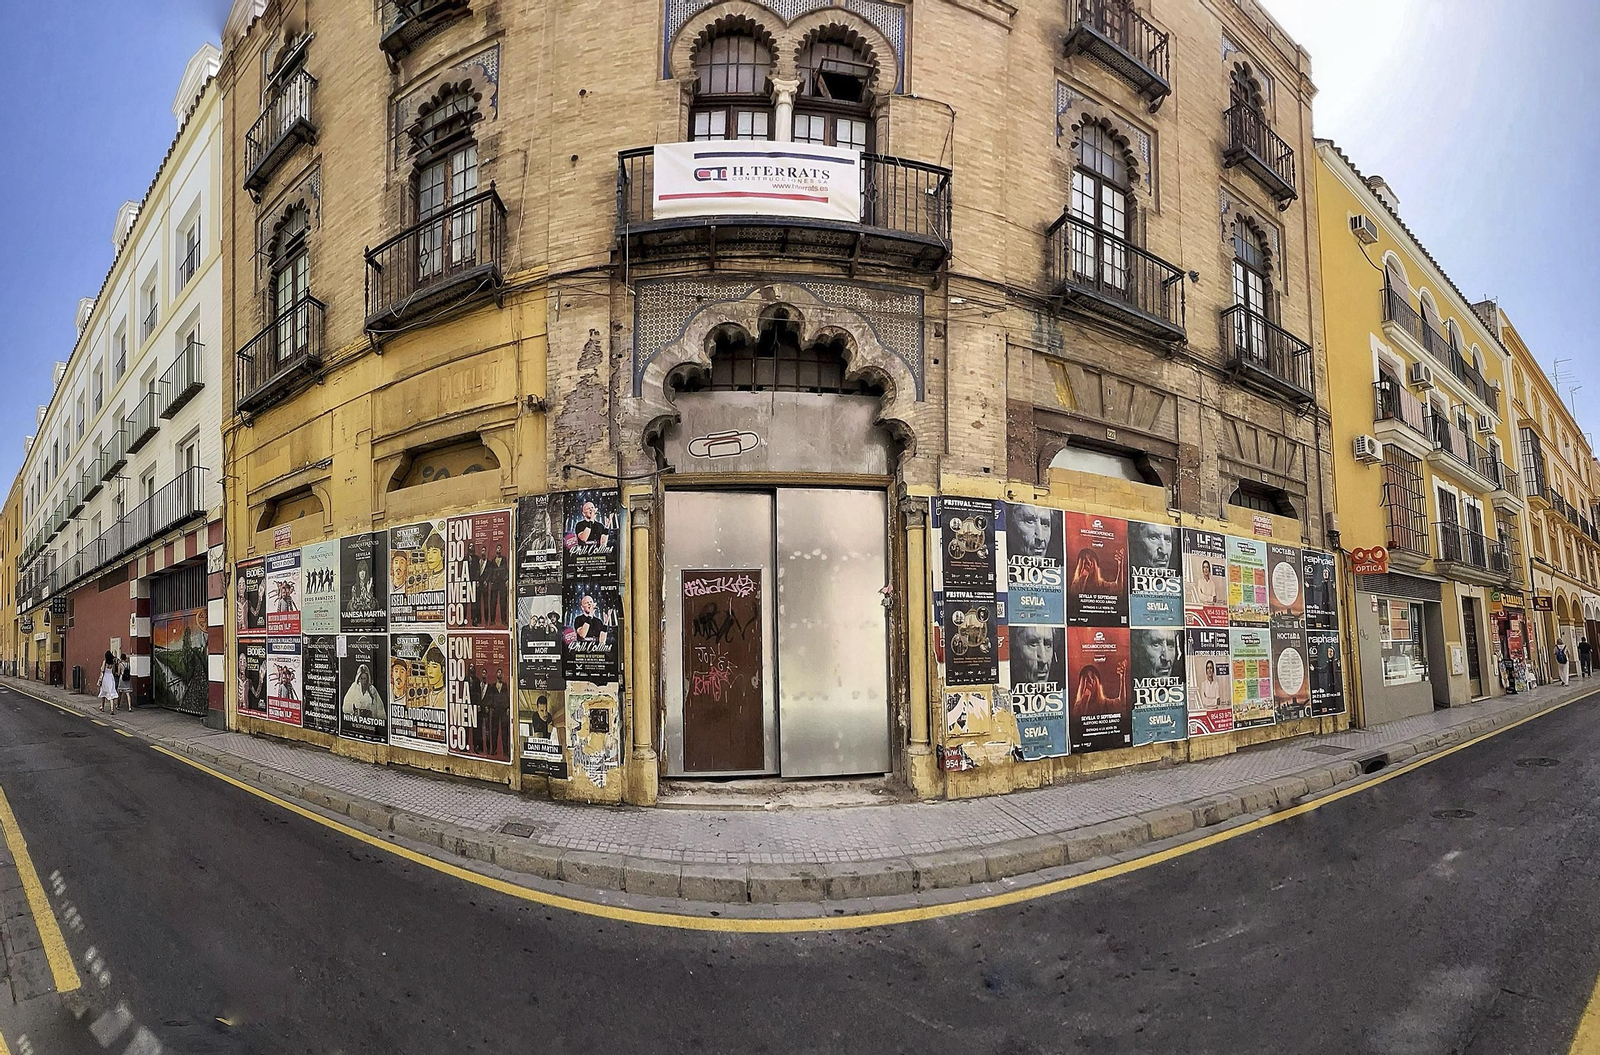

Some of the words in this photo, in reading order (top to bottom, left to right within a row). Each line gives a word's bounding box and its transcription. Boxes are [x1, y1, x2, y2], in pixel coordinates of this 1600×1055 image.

[733, 166, 830, 180] H.TERRATS
[772, 183, 828, 192] www.hterrats.es
[448, 519, 472, 541] FON
[1197, 533, 1210, 545] ILF
[448, 541, 464, 561] DO
[588, 545, 614, 556] Collins
[1007, 555, 1060, 568] MIGUEL
[1304, 556, 1335, 566] raphael
[246, 567, 265, 578] BODIES
[448, 561, 470, 582] FLA
[1008, 566, 1061, 585] RIOS
[1132, 566, 1180, 578] MIGUEL
[1355, 564, 1383, 574] ÓPTICA
[1132, 576, 1181, 593] RIOS
[448, 581, 476, 603] MEN
[391, 595, 404, 606] ISEO
[407, 592, 445, 606] DODOSOUND
[1147, 602, 1169, 611] SEVILLA
[341, 610, 363, 619] VANESA
[363, 608, 386, 618] MARTÍN
[448, 603, 468, 625] CO.
[1201, 632, 1214, 643] ILF
[1308, 634, 1339, 644] raphael
[247, 647, 266, 657] BODIES
[448, 637, 473, 659] FON
[587, 641, 612, 653] Collins
[449, 659, 465, 681] DO
[1012, 681, 1063, 694] MIGUEL
[1133, 677, 1183, 688] MIGUEL
[449, 680, 471, 704] FLA
[1134, 686, 1184, 705] RIOS
[1012, 692, 1063, 713] RIOS
[392, 705, 405, 718] ISEO
[449, 703, 478, 728] MEN
[344, 714, 358, 723] NIÑA
[359, 717, 385, 726] PASTORI
[1149, 715, 1172, 726] SEVILLA
[449, 725, 470, 751] CO.
[945, 760, 959, 768] 954
